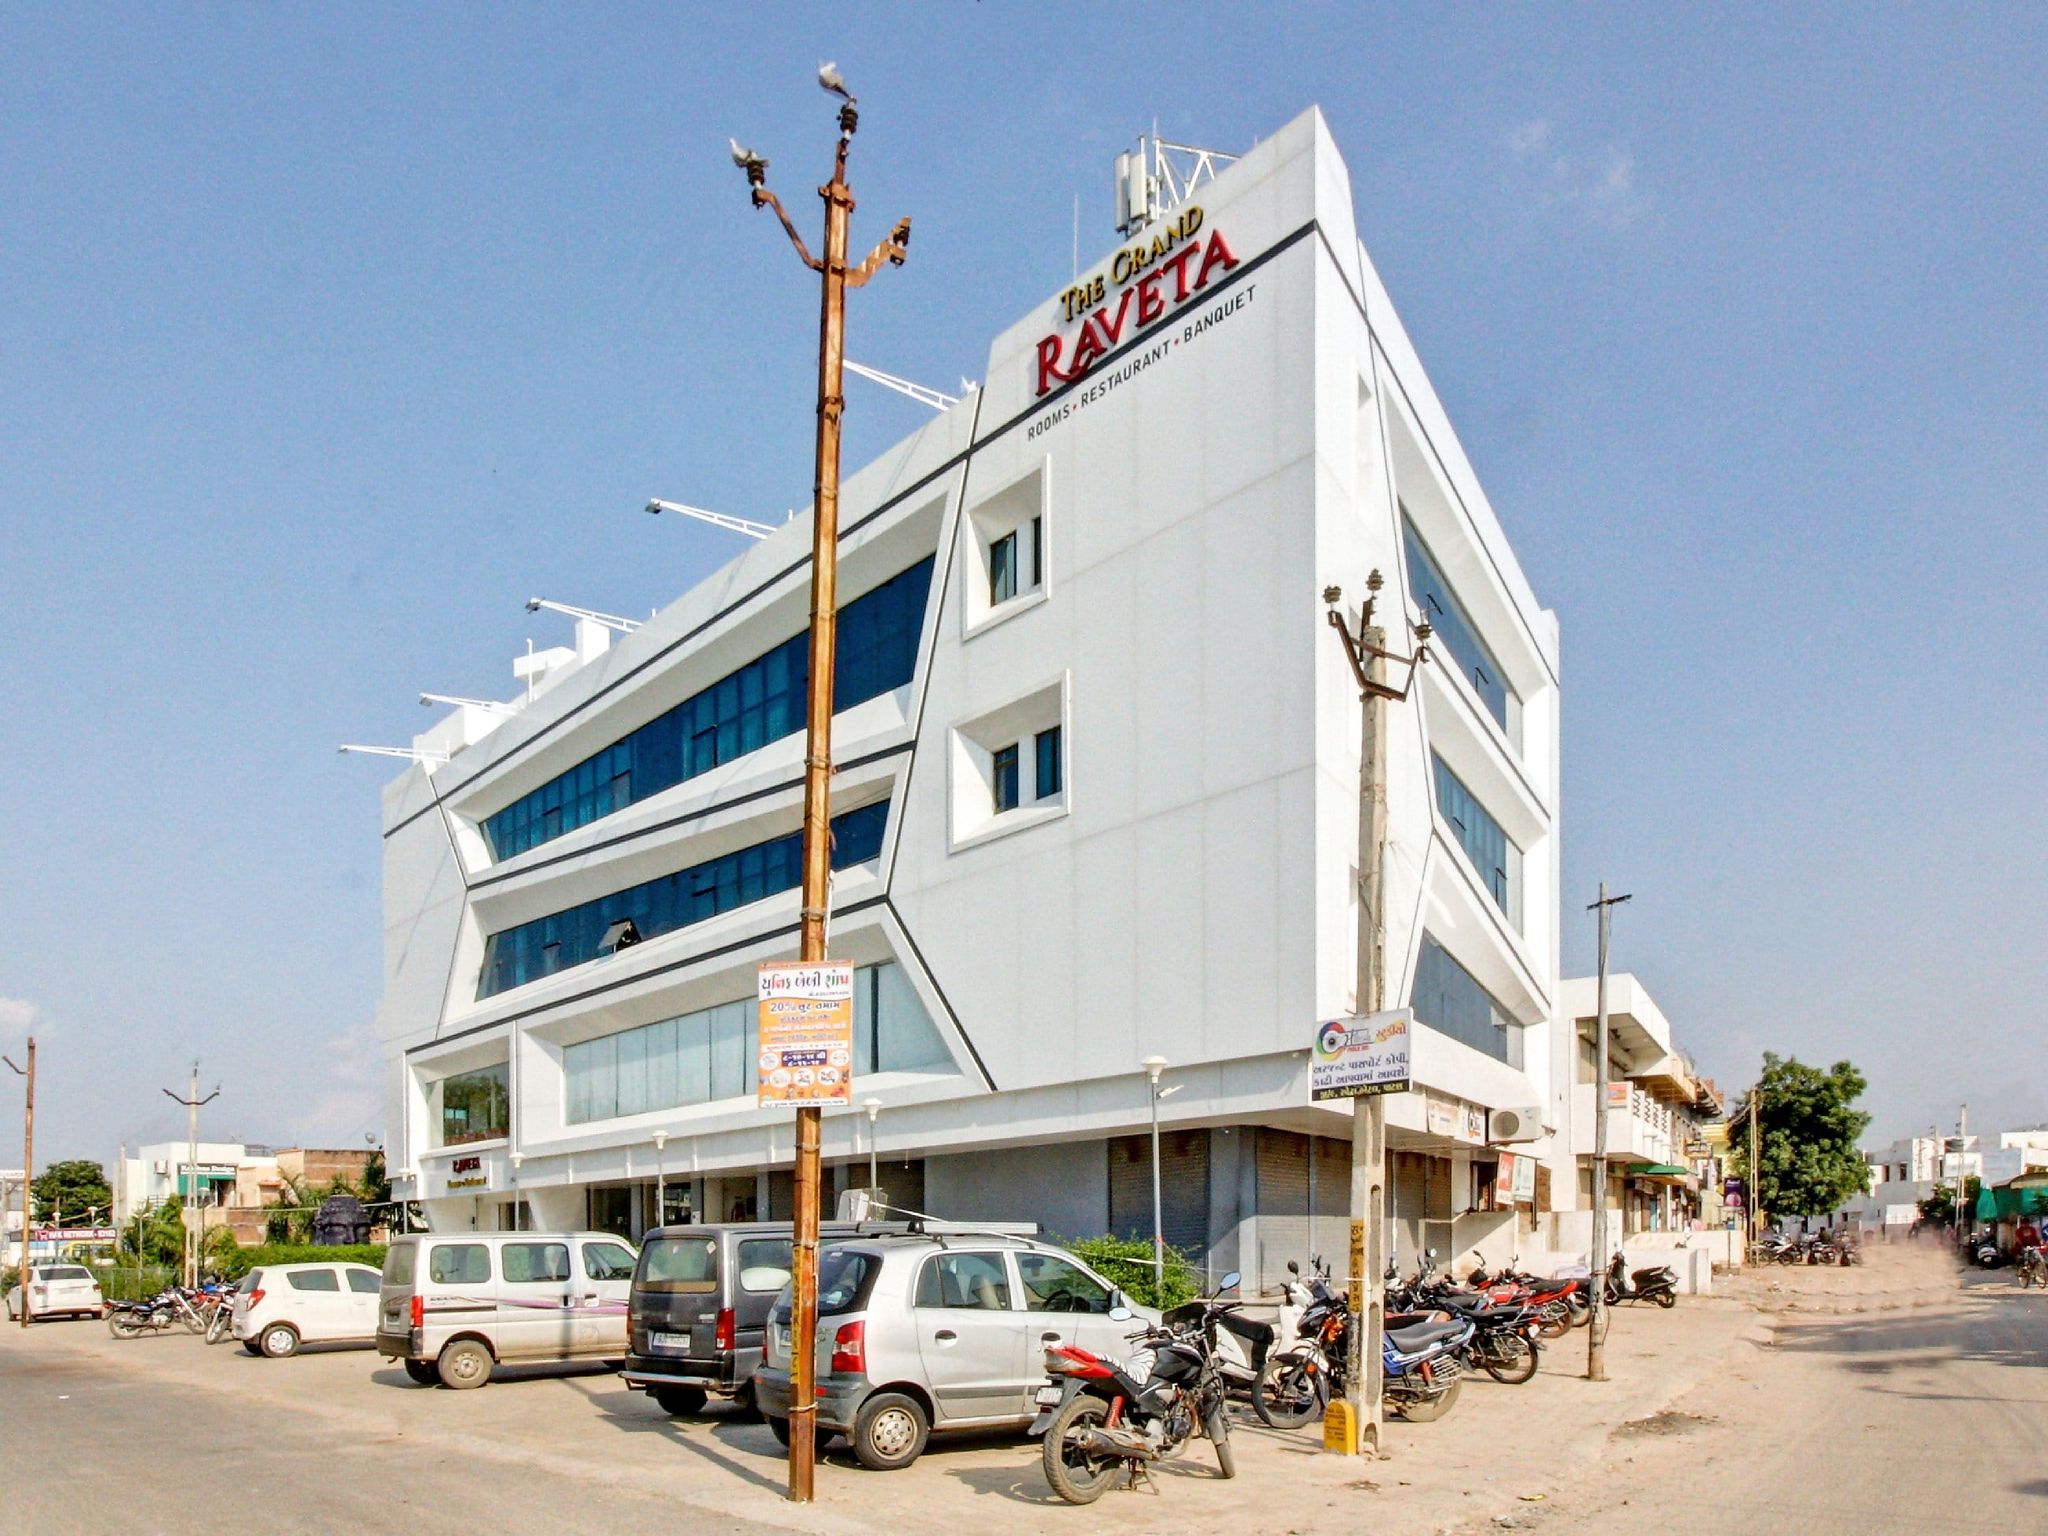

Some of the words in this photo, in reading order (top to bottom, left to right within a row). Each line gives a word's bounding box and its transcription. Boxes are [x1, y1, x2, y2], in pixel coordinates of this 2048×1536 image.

[1034, 228, 1241, 397] RAVETA
[1061, 273, 1105, 322] THE
[1111, 204, 1204, 286] GRAND
[1027, 403, 1070, 442] ROOMS
[1080, 338, 1171, 408] RESTAURANT
[1184, 284, 1257, 343] BANQUET
